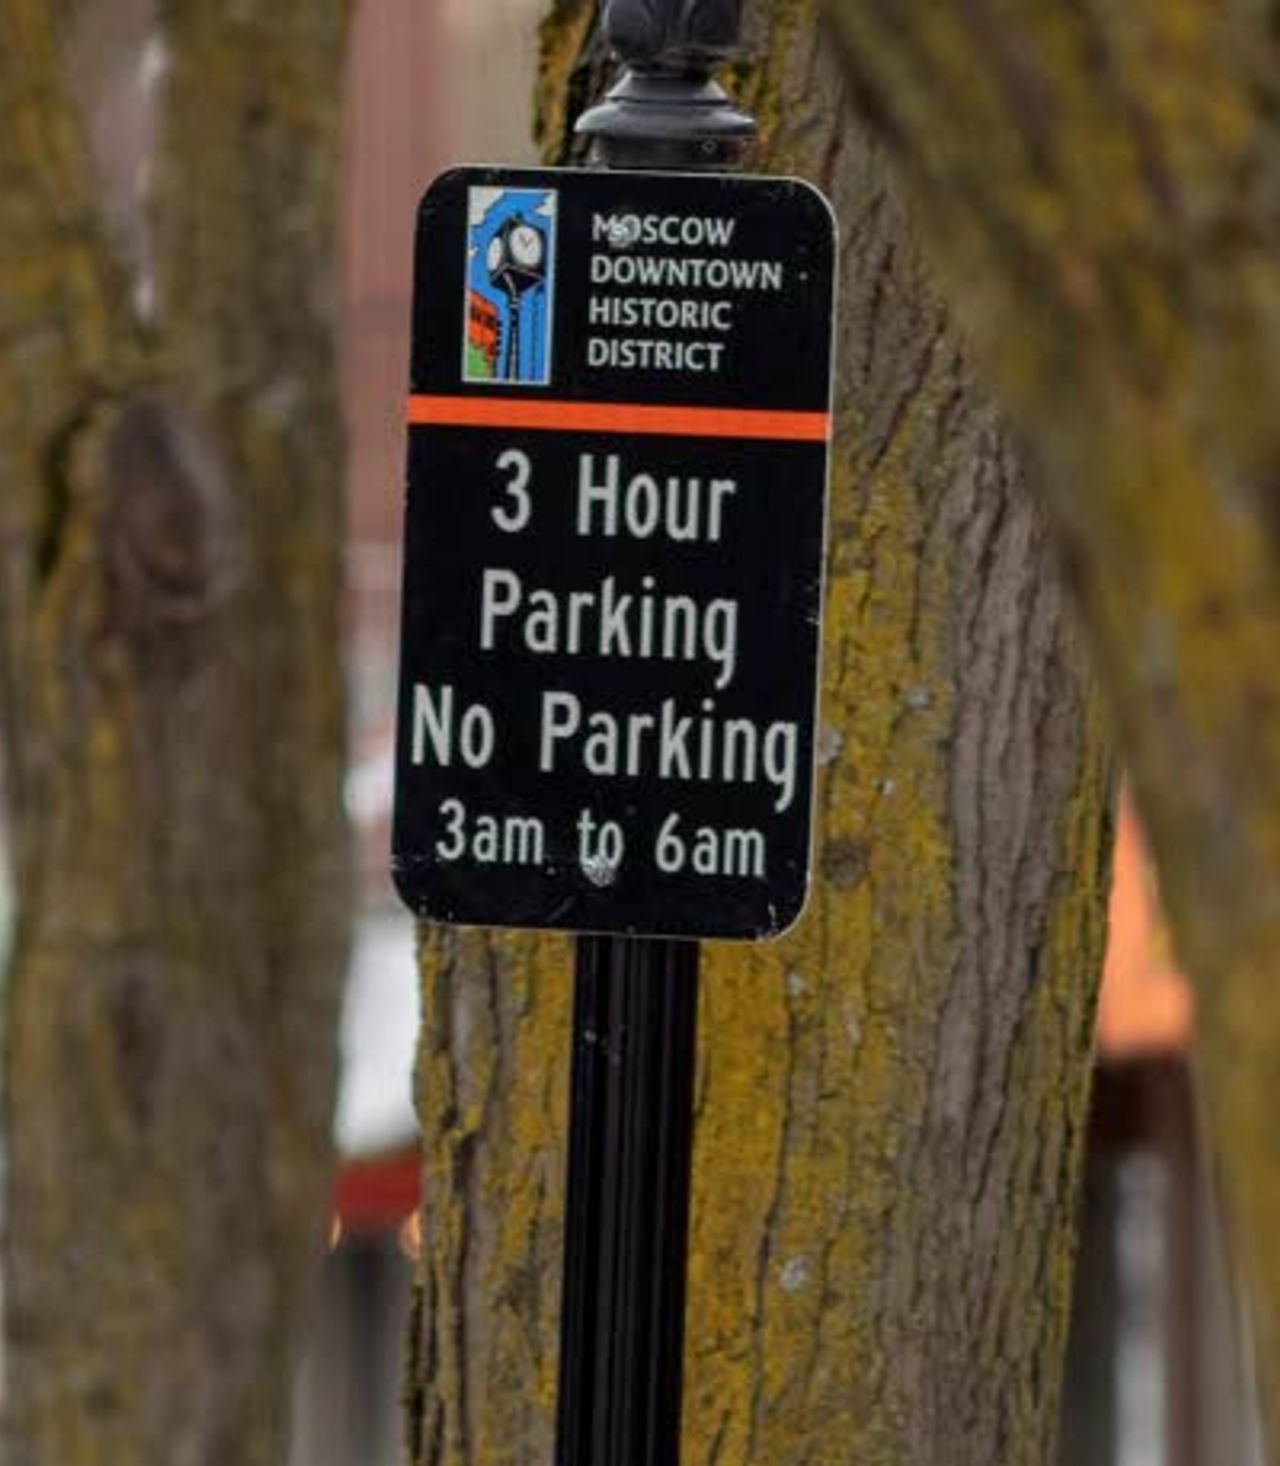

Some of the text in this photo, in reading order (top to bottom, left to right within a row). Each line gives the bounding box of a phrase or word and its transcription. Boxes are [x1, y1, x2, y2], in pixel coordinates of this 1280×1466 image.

[592, 214, 734, 246] MOSCOW
[591, 255, 782, 289] DOWNTOWN
[589, 298, 731, 329] HISTORIC
[588, 339, 724, 371] DISTRICT
[491, 449, 736, 541] 3 Hour
[480, 569, 737, 689] Parking
[411, 684, 798, 812] No Parking
[437, 799, 766, 876] 3am to 6am
